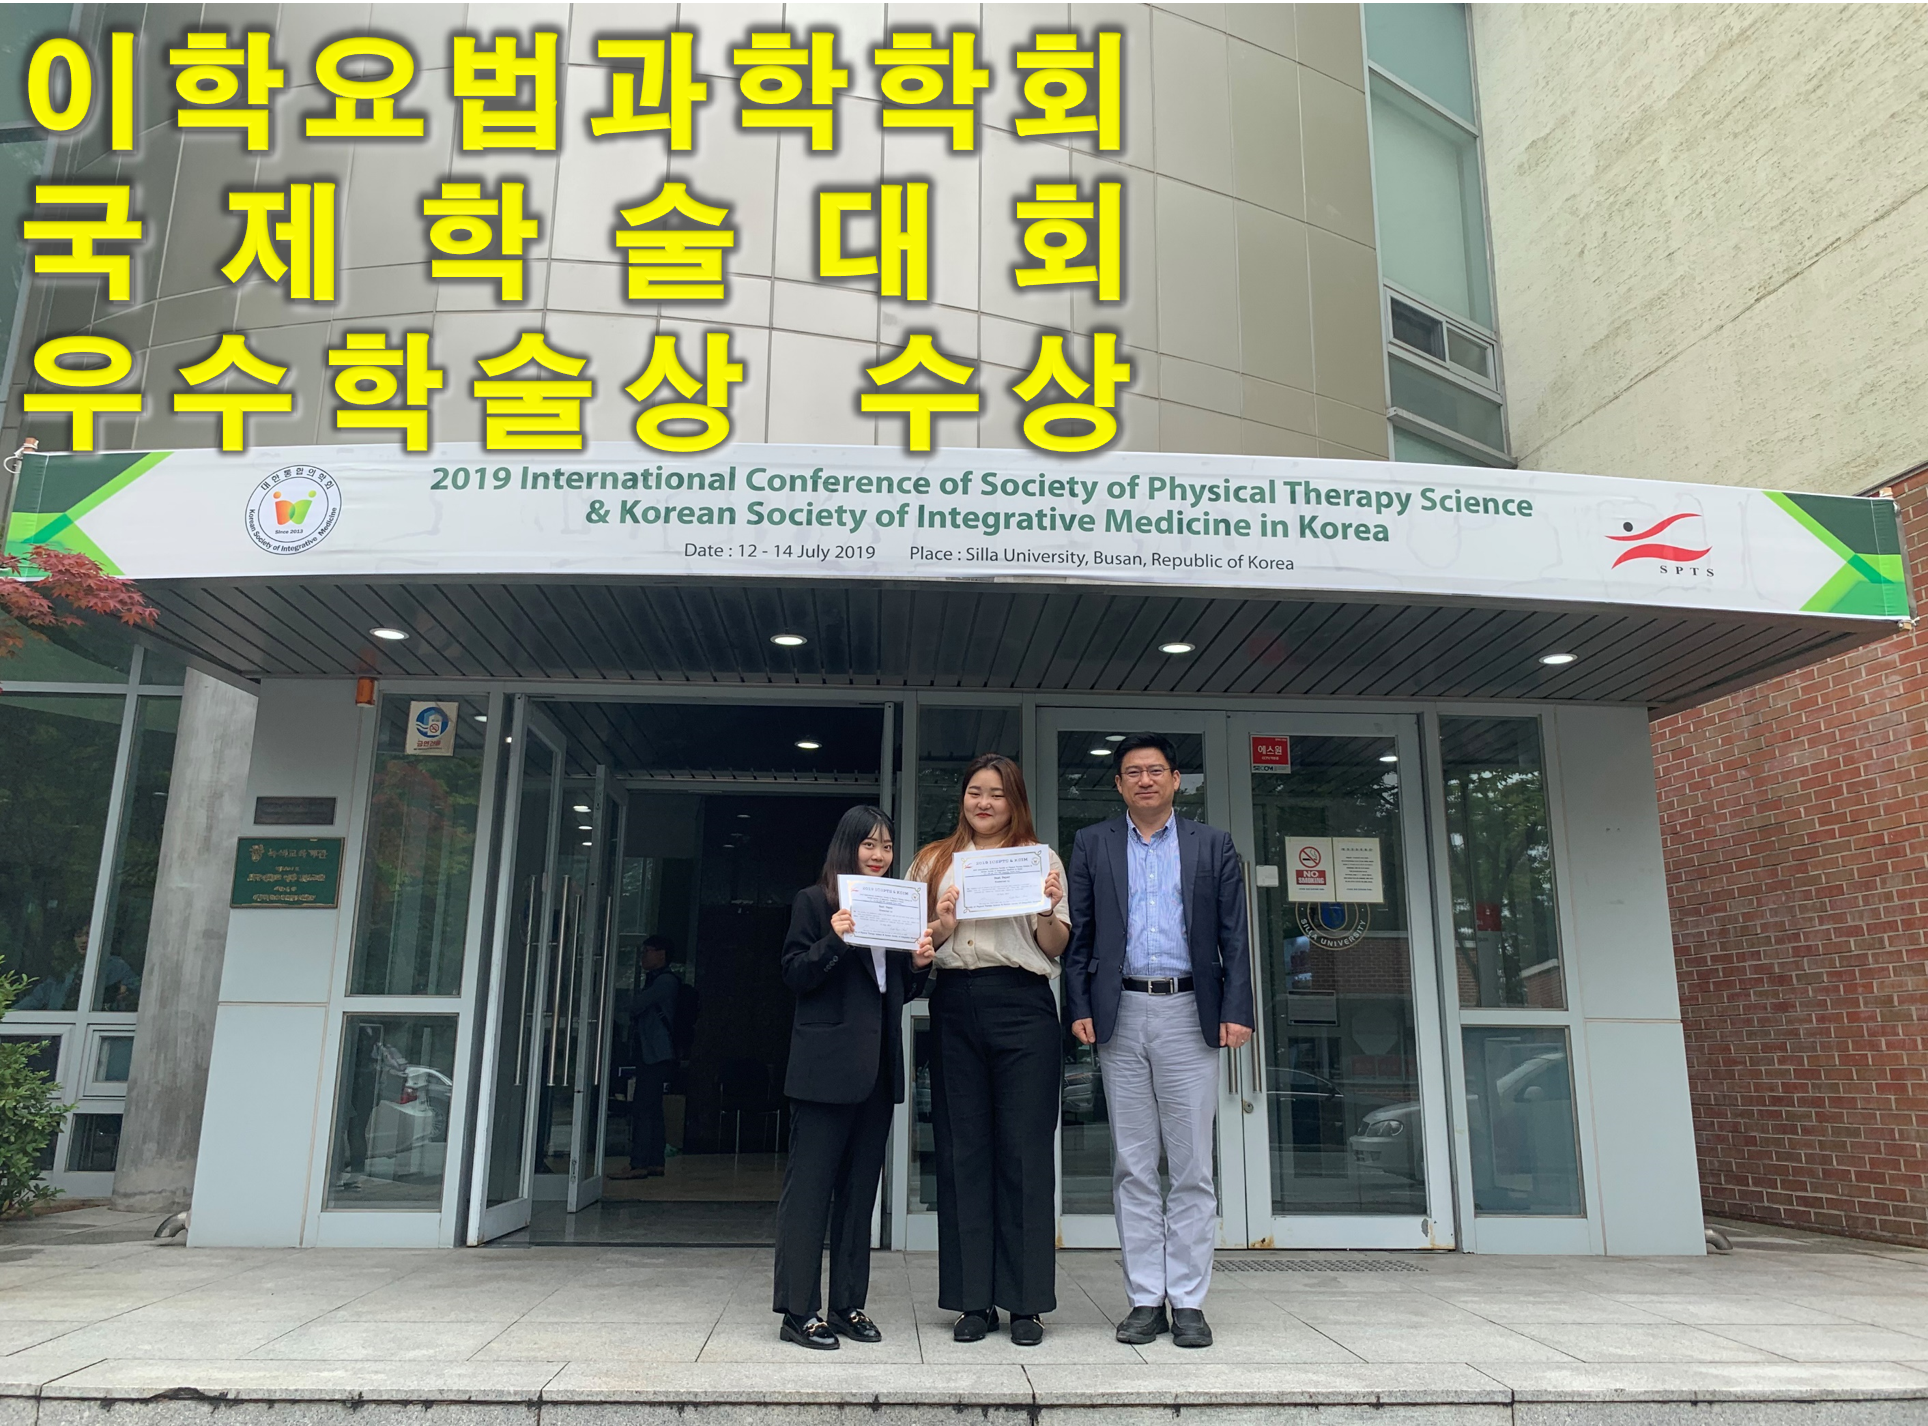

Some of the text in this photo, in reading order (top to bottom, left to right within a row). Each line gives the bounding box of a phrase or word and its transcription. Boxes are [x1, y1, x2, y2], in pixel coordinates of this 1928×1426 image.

[430, 465, 1534, 518] 2019 International Conference of Society of Physical Therapy Science
[585, 499, 1390, 542] & Korean Society of Integrative Medicine in Korea
[684, 542, 724, 557] Date
[738, 544, 757, 558] 12
[774, 544, 793, 558] 14
[797, 544, 831, 561] July
[834, 545, 876, 559] 2019
[910, 545, 953, 561] Place
[966, 547, 999, 562] Silla
[1004, 548, 1089, 567] University,
[1094, 550, 1147, 567] Busan,
[1151, 552, 1223, 570] Republic
[1227, 554, 1245, 569] of
[1248, 555, 1294, 571] Korea
[1257, 745, 1282, 755] 에스원
[1303, 870, 1319, 878] NO
[1300, 918, 1367, 947] SILLA UNIVERSITY
